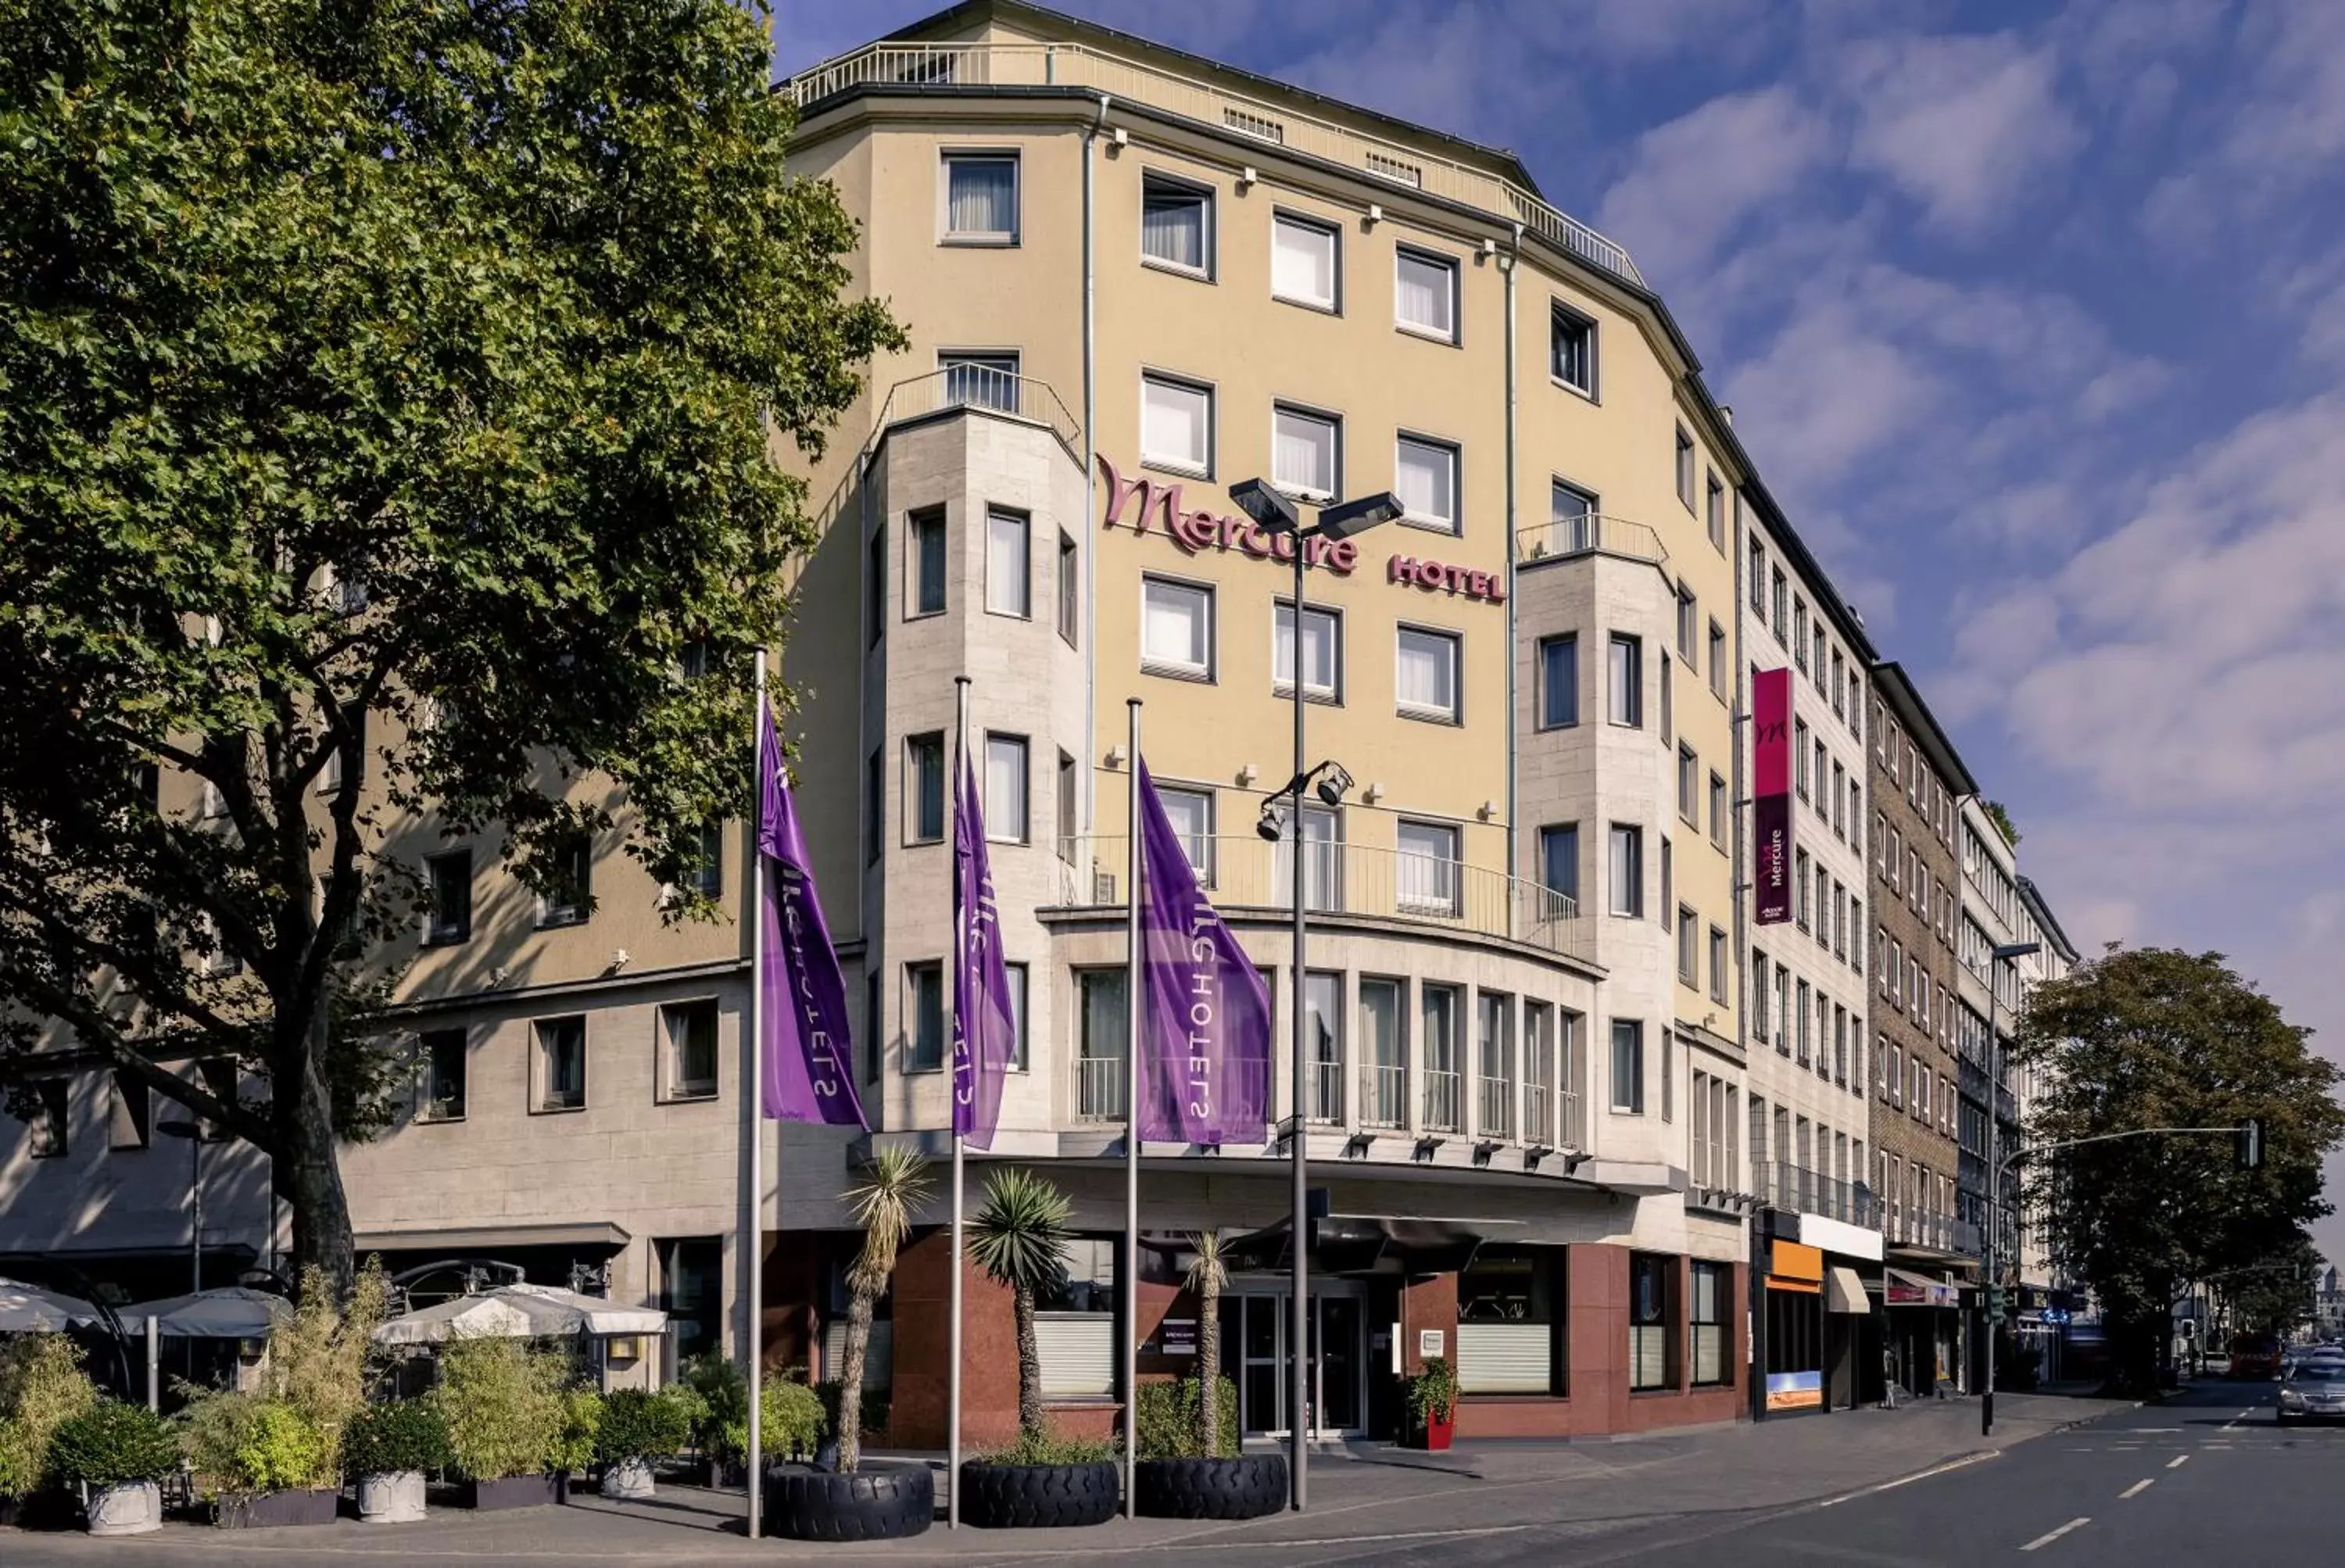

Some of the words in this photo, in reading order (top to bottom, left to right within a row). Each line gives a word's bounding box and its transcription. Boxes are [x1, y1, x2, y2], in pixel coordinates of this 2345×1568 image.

[1094, 451, 1359, 574] Mercure
[1390, 553, 1506, 602] HOTEL
[1770, 829, 1781, 888] Mercure
